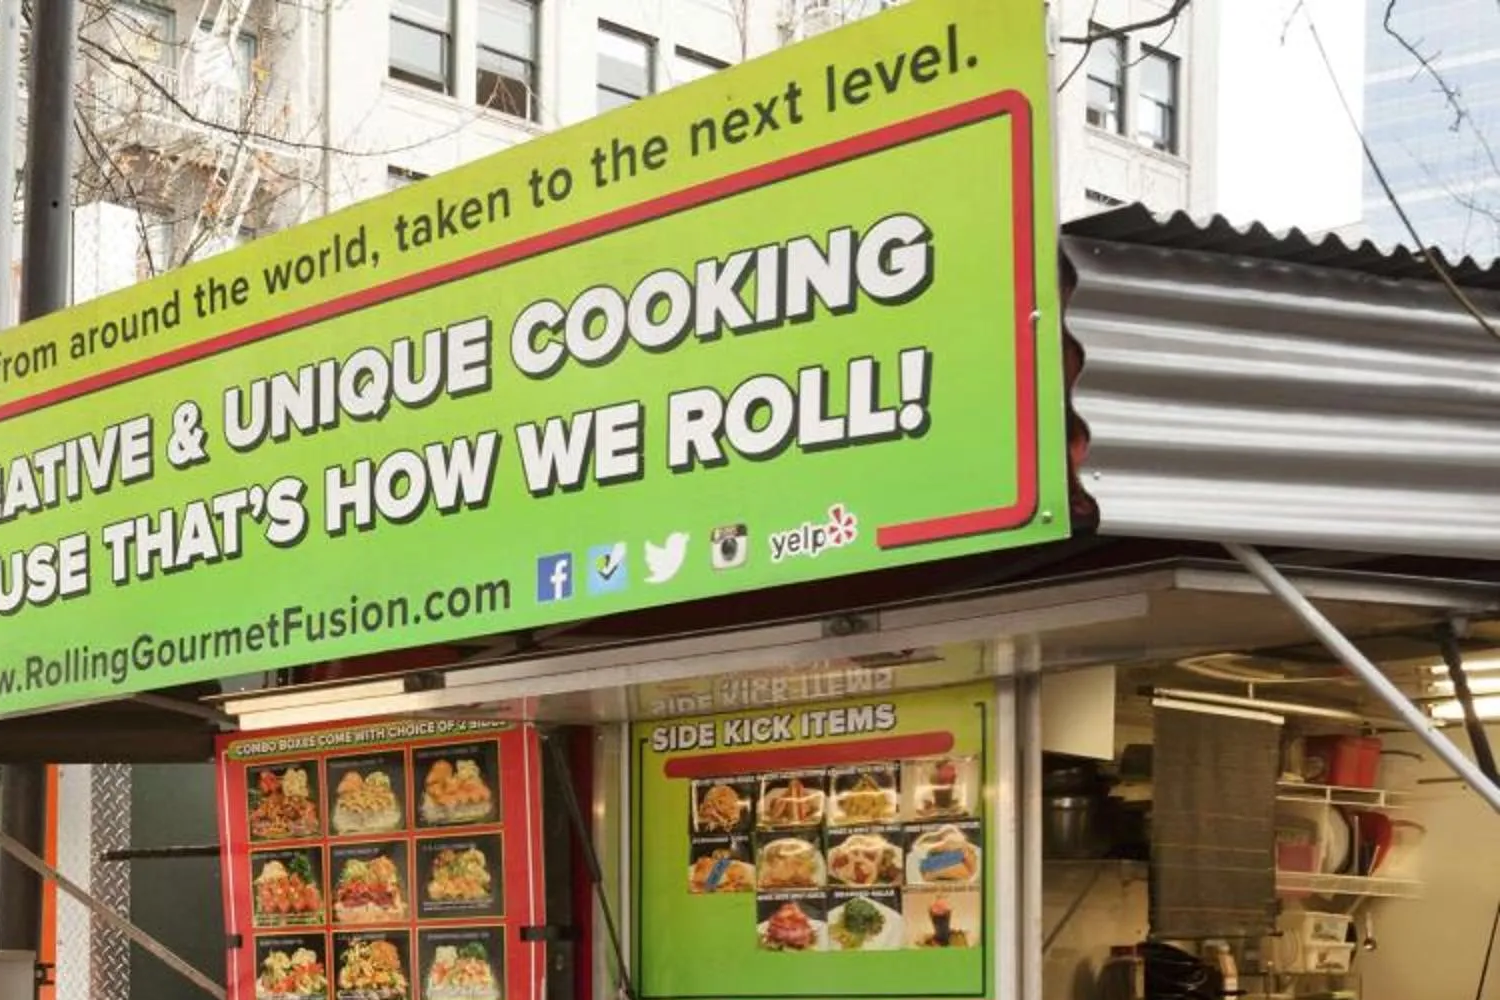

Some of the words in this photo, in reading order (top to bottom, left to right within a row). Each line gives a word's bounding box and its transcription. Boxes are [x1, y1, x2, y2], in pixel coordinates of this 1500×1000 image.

[69, 292, 181, 361] around
[194, 270, 250, 319] the
[263, 227, 380, 295] world,
[395, 186, 511, 252] taken
[528, 161, 573, 210] to
[591, 139, 669, 189] the
[690, 82, 805, 157] next
[824, 23, 979, 112] level.
[166, 401, 208, 465] &
[222, 316, 492, 450] UNIQUE
[510, 212, 935, 380] COOKING
[104, 476, 307, 585] THAT'S
[324, 431, 497, 537] HOW
[517, 401, 643, 495] WE
[667, 347, 933, 472] ROLL!
[770, 523, 827, 560] yelp
[235, 742, 277, 757] COMBO
[319, 732, 352, 746] COME
[354, 728, 386, 742] WITH
[387, 723, 435, 739] CHOICE
[437, 720, 455, 734] OF
[653, 724, 715, 752] SIDE
[723, 713, 794, 745] KICK
[800, 704, 896, 738] ITEMS
